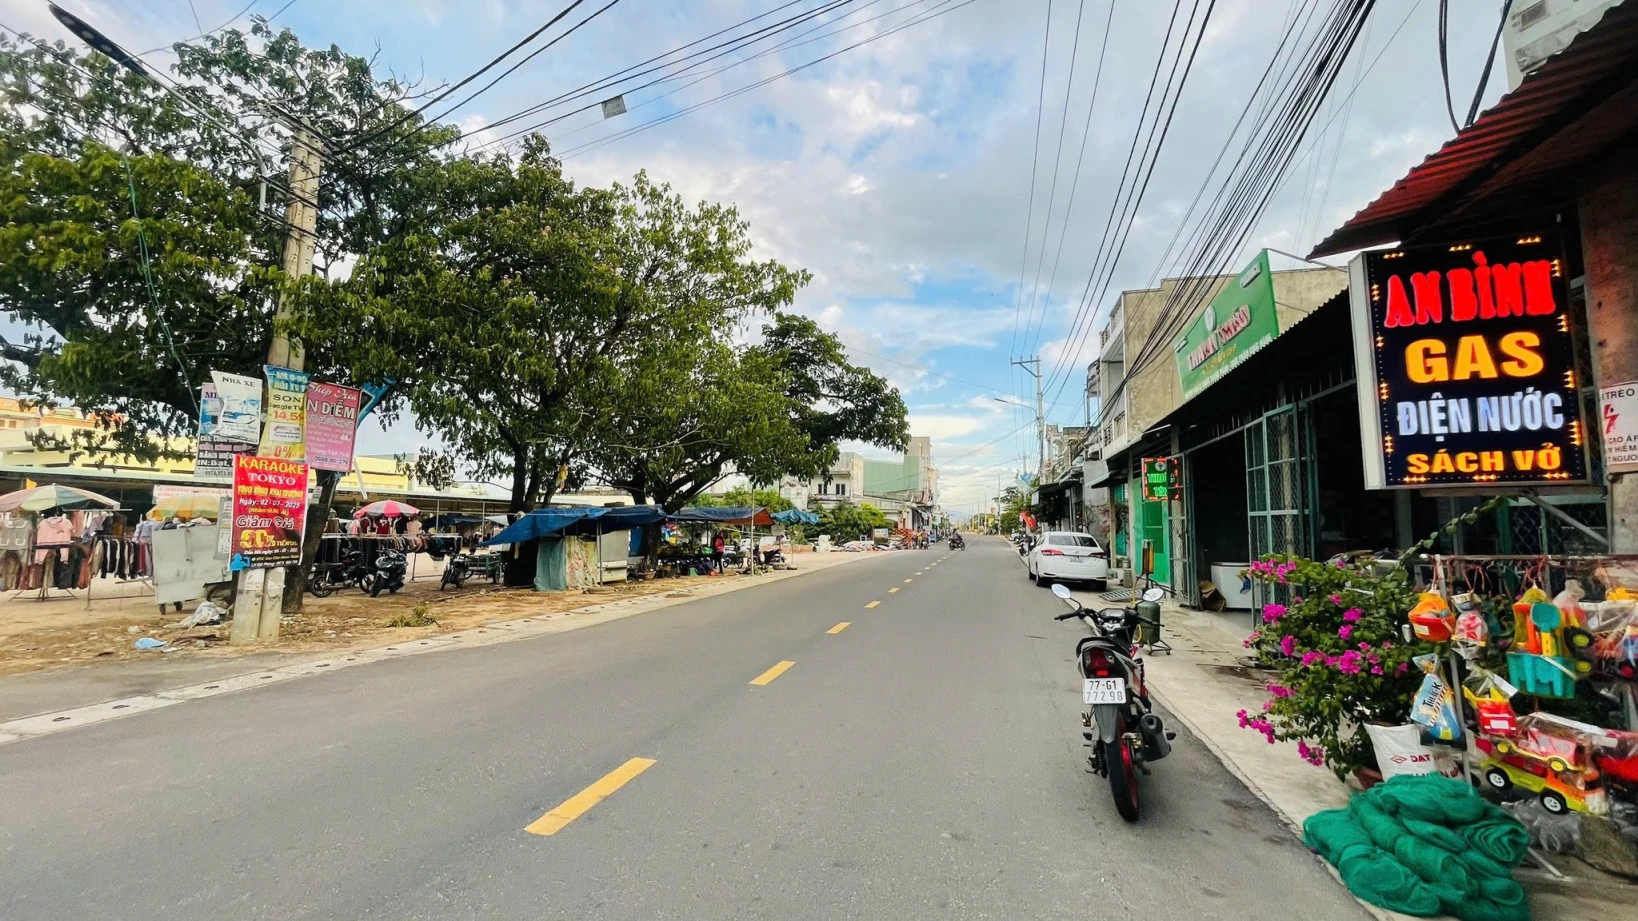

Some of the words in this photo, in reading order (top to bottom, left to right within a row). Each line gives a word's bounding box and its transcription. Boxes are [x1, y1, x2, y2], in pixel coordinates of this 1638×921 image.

[1384, 271, 1442, 328] AN
[1446, 250, 1555, 321] BÌNH
[1404, 331, 1544, 384] GAS
[222, 376, 242, 385] NHÀ
[1396, 392, 1472, 442] ĐIỆN
[1476, 386, 1565, 433] NƯỚC
[239, 457, 304, 474] KARAOKE
[1406, 448, 1504, 474] SÁCH
[248, 472, 296, 486] TOKYO
[236, 514, 272, 528] Giảm
[274, 516, 294, 529] Giá
[240, 529, 276, 548] 50%
[1089, 680, 1117, 690] 77-G1
[1086, 691, 1123, 702] 772.98
